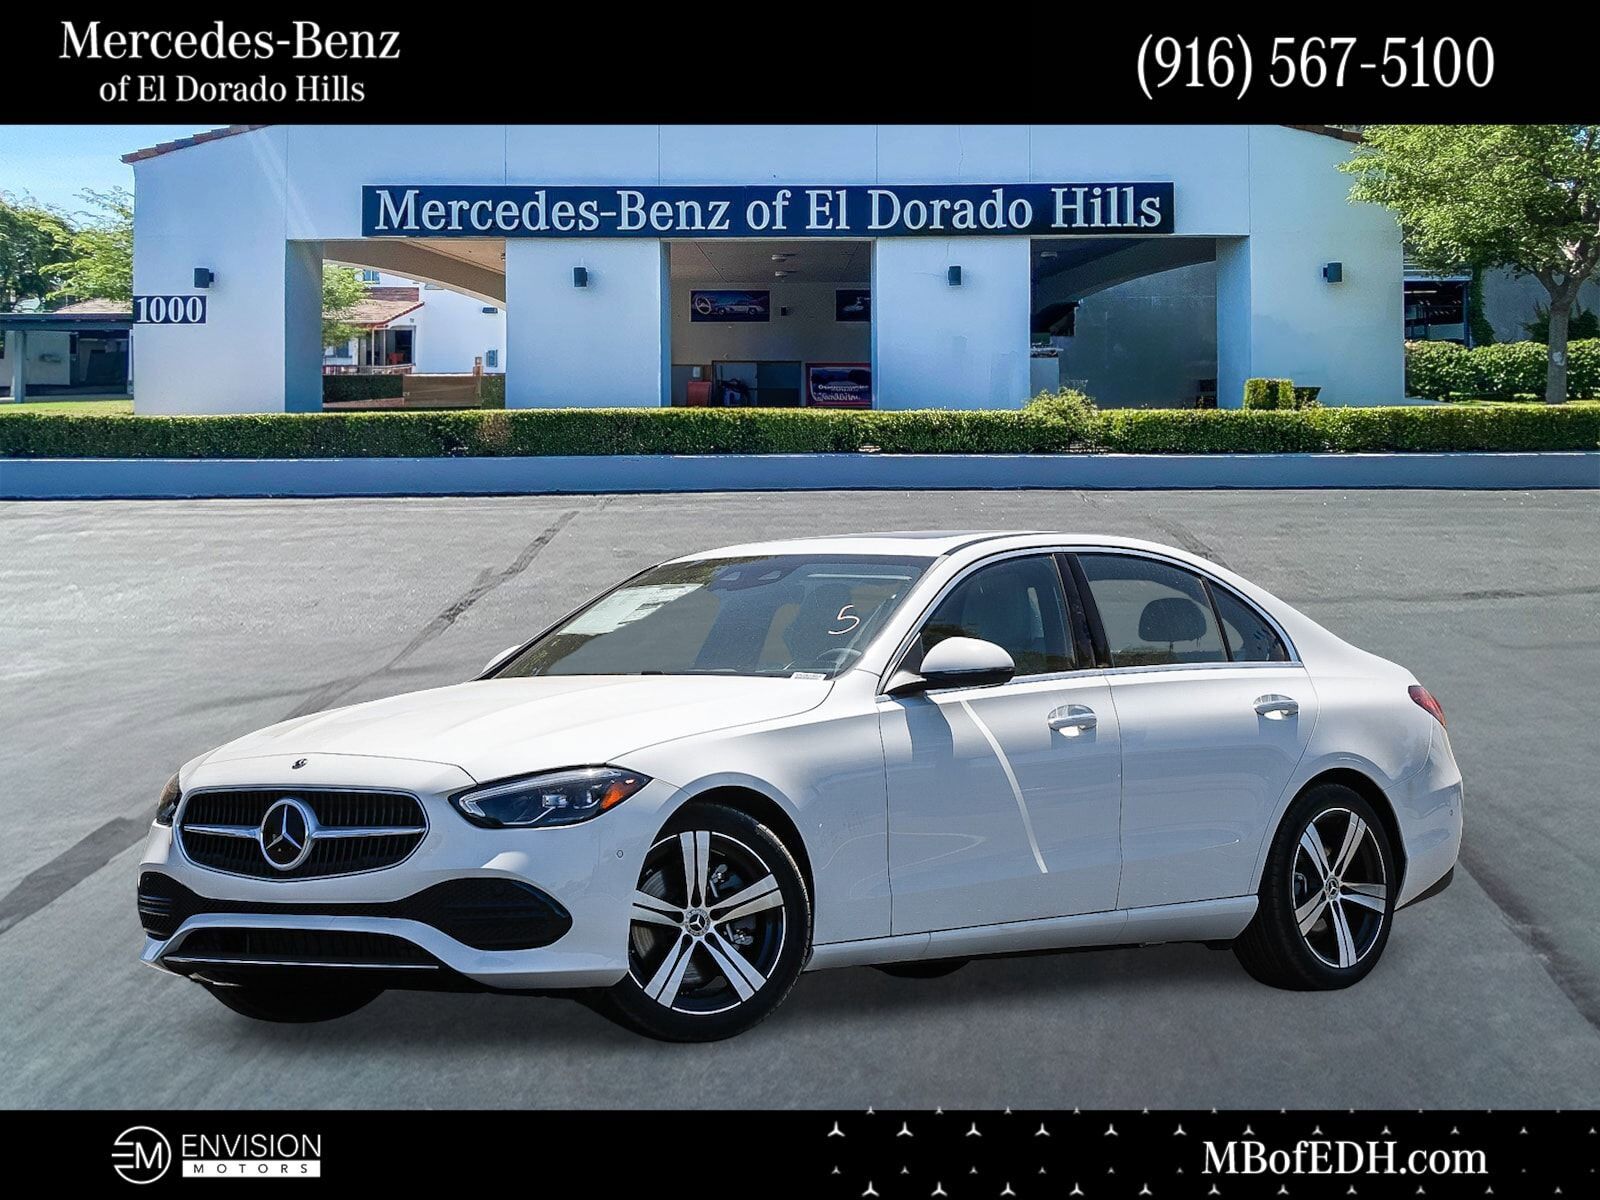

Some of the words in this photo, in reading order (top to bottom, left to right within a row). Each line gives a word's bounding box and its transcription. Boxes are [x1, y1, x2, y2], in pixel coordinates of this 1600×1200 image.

[374, 189, 730, 231] Mercedes-Benz
[746, 189, 792, 230] of
[805, 189, 850, 230] El
[867, 188, 1033, 230] Dorado
[1051, 187, 1162, 228] Hills
[136, 297, 203, 323] 1000
